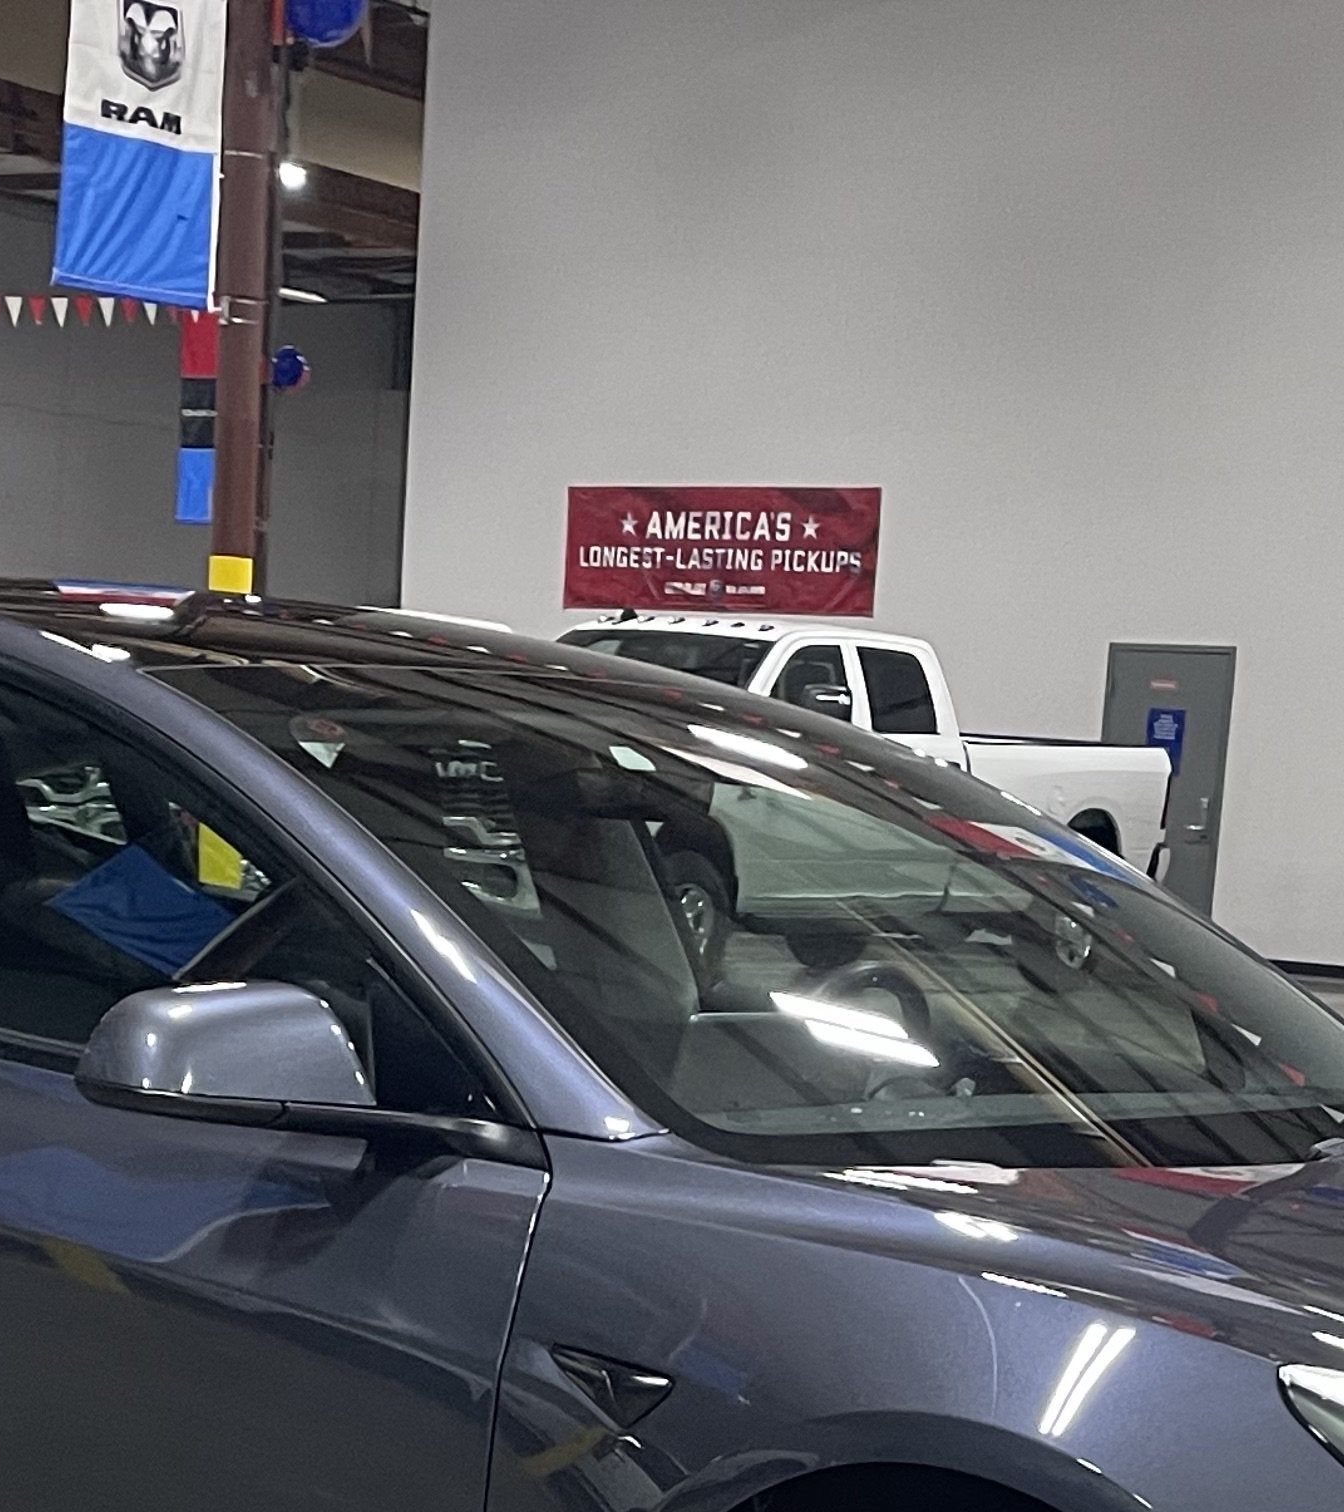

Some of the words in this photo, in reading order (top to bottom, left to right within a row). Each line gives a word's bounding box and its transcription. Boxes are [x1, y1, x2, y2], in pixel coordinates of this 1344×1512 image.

[100, 98, 182, 135] RAM
[645, 511, 792, 542] AMERICA'S
[579, 546, 763, 573] LONGEST-LASTING
[770, 550, 861, 574] PICKUPS
